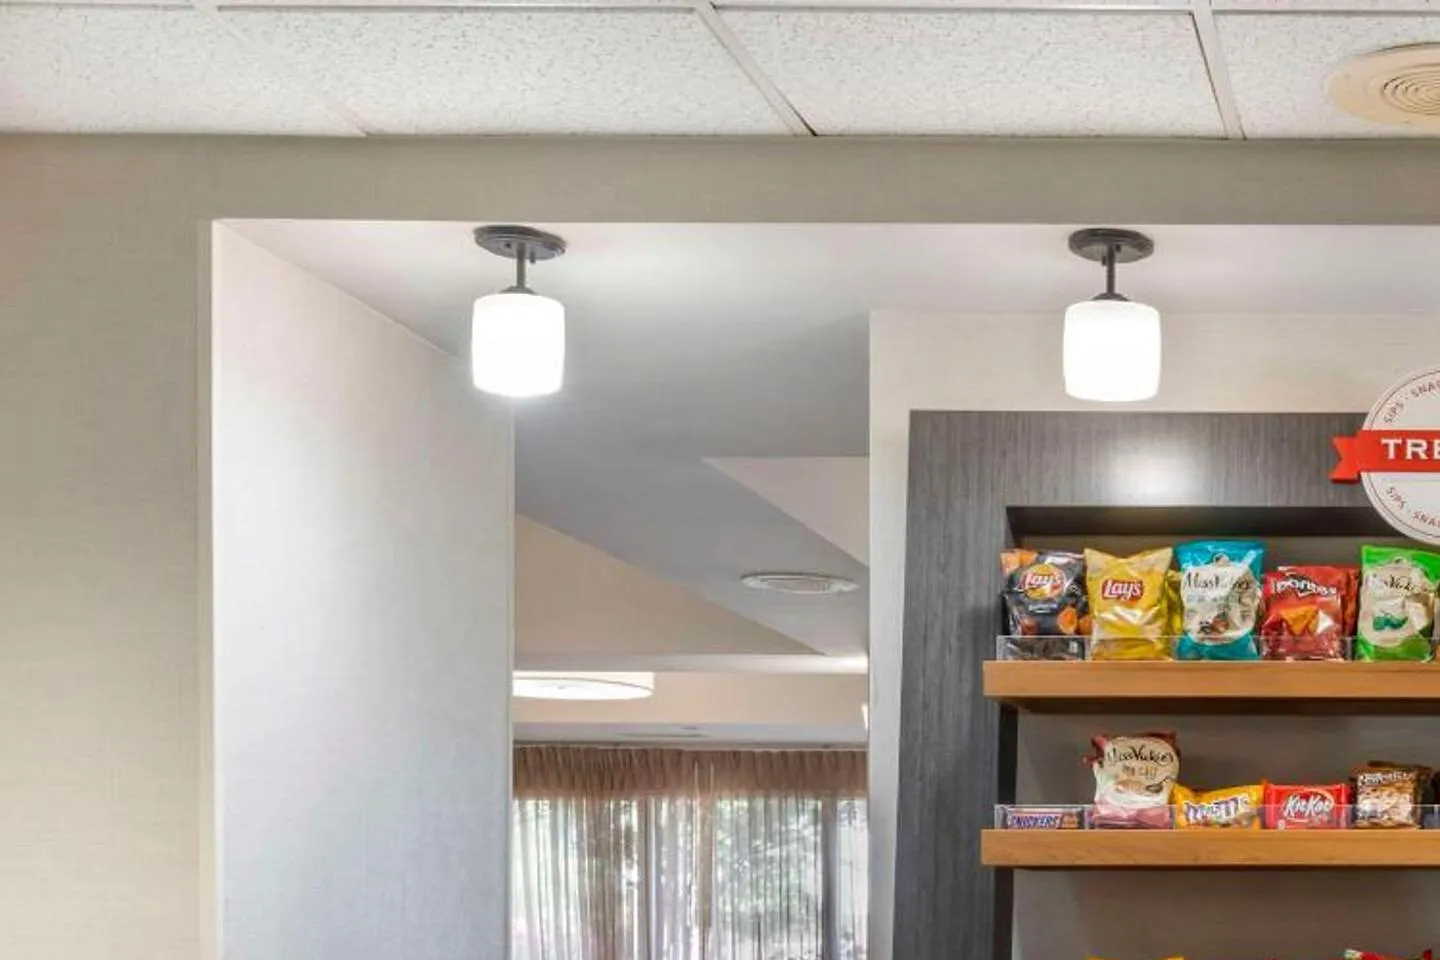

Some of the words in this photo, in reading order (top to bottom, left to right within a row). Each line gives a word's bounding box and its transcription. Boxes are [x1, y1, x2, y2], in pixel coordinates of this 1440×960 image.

[1384, 400, 1405, 424] SIPS
[1386, 486, 1406, 512] SIPS
[1103, 579, 1143, 600] Lay's
